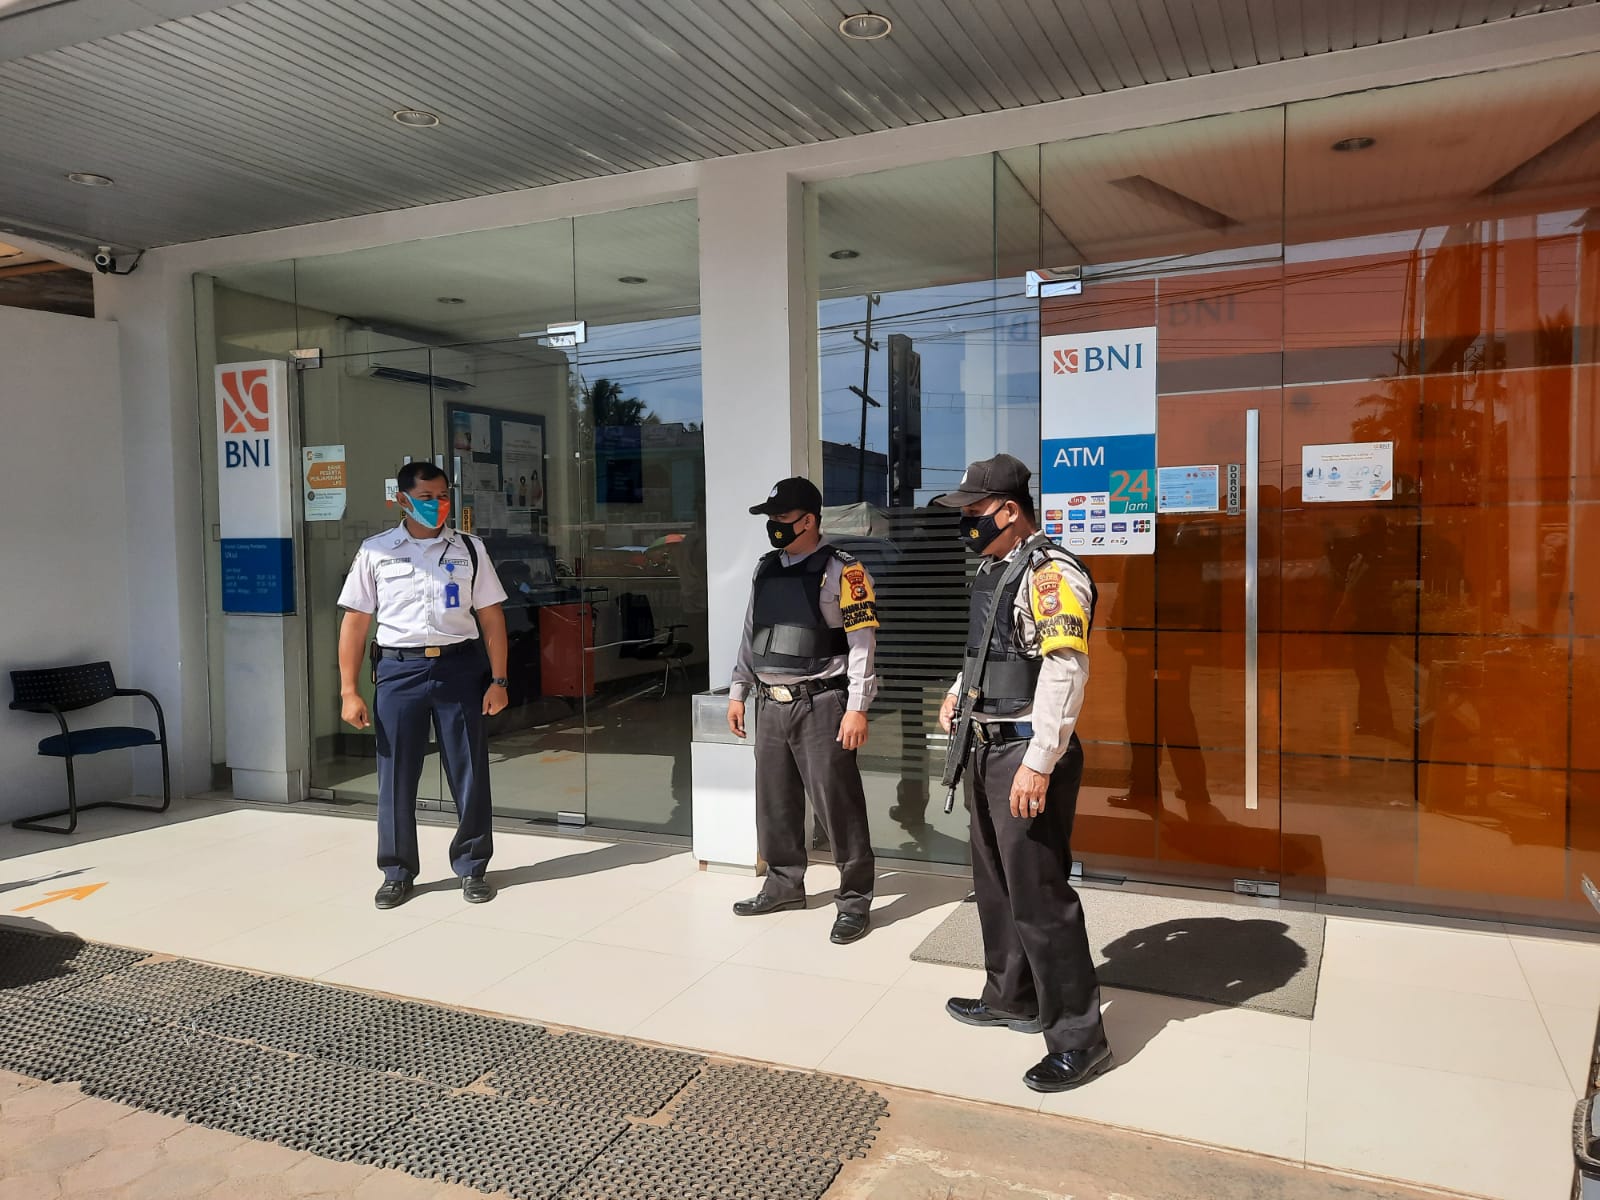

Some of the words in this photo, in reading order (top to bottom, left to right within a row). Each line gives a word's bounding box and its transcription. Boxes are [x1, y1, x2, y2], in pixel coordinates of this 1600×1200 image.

[1084, 343, 1143, 373] BNI
[225, 438, 270, 468] BNI
[1053, 447, 1105, 468] ATM
[1110, 471, 1151, 501] 24
[1230, 465, 1238, 506] DORONG
